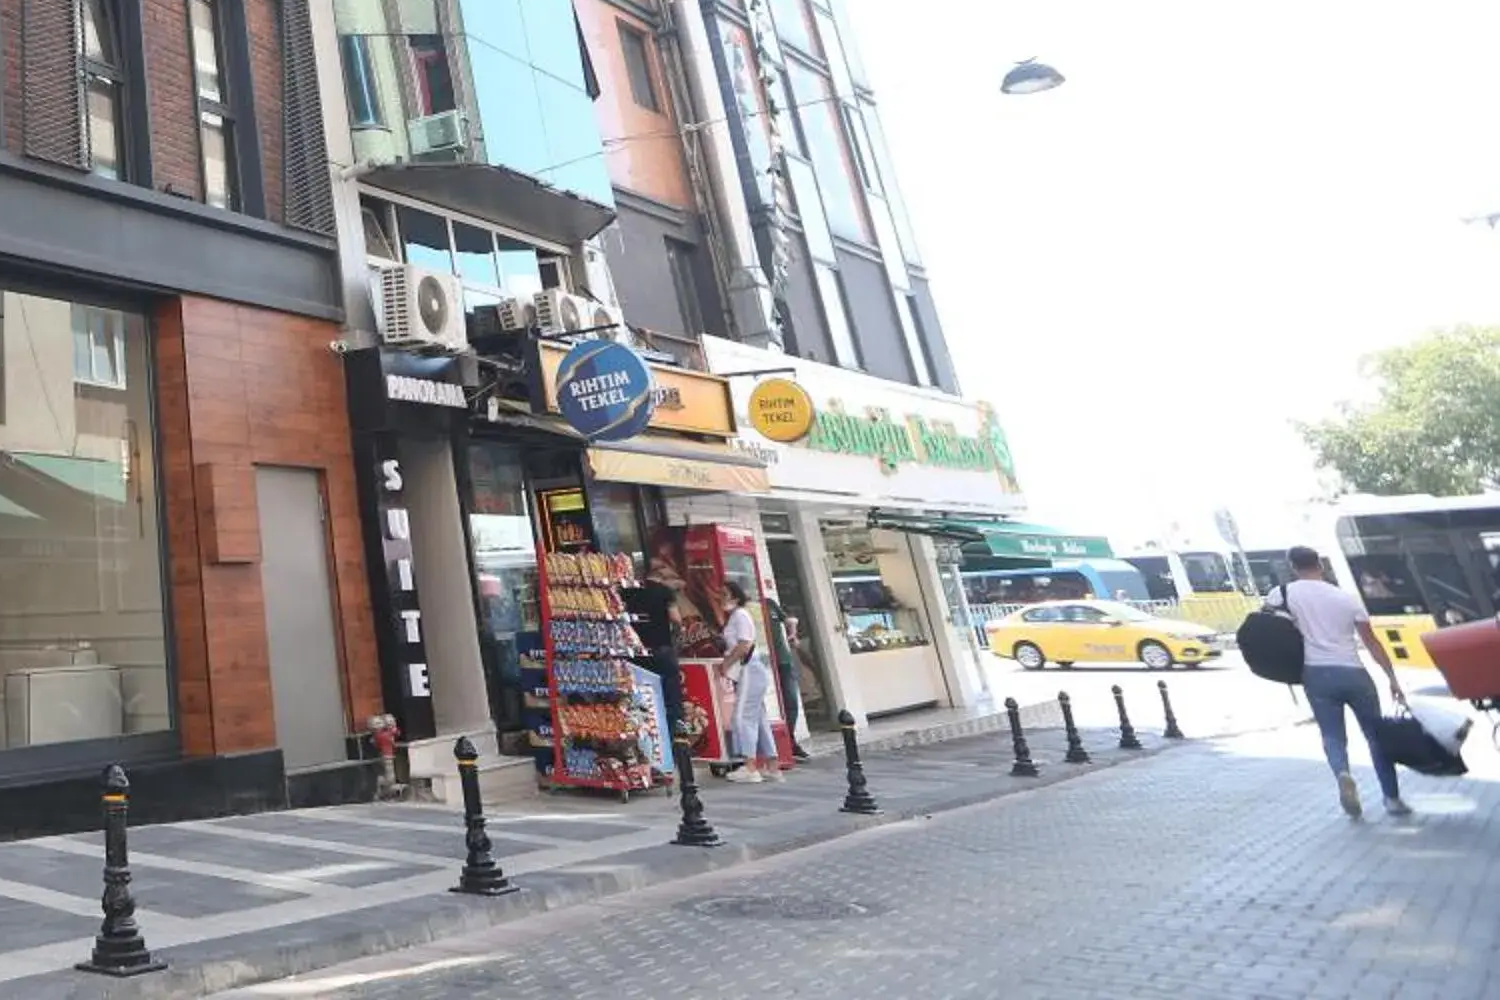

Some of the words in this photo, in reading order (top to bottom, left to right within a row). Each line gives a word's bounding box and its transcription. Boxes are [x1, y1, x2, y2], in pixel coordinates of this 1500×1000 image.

[386, 374, 469, 409] PANORAMA
[569, 370, 631, 397] RIHTIM
[578, 388, 630, 412] TEKEL
[383, 459, 431, 696] SUITE
